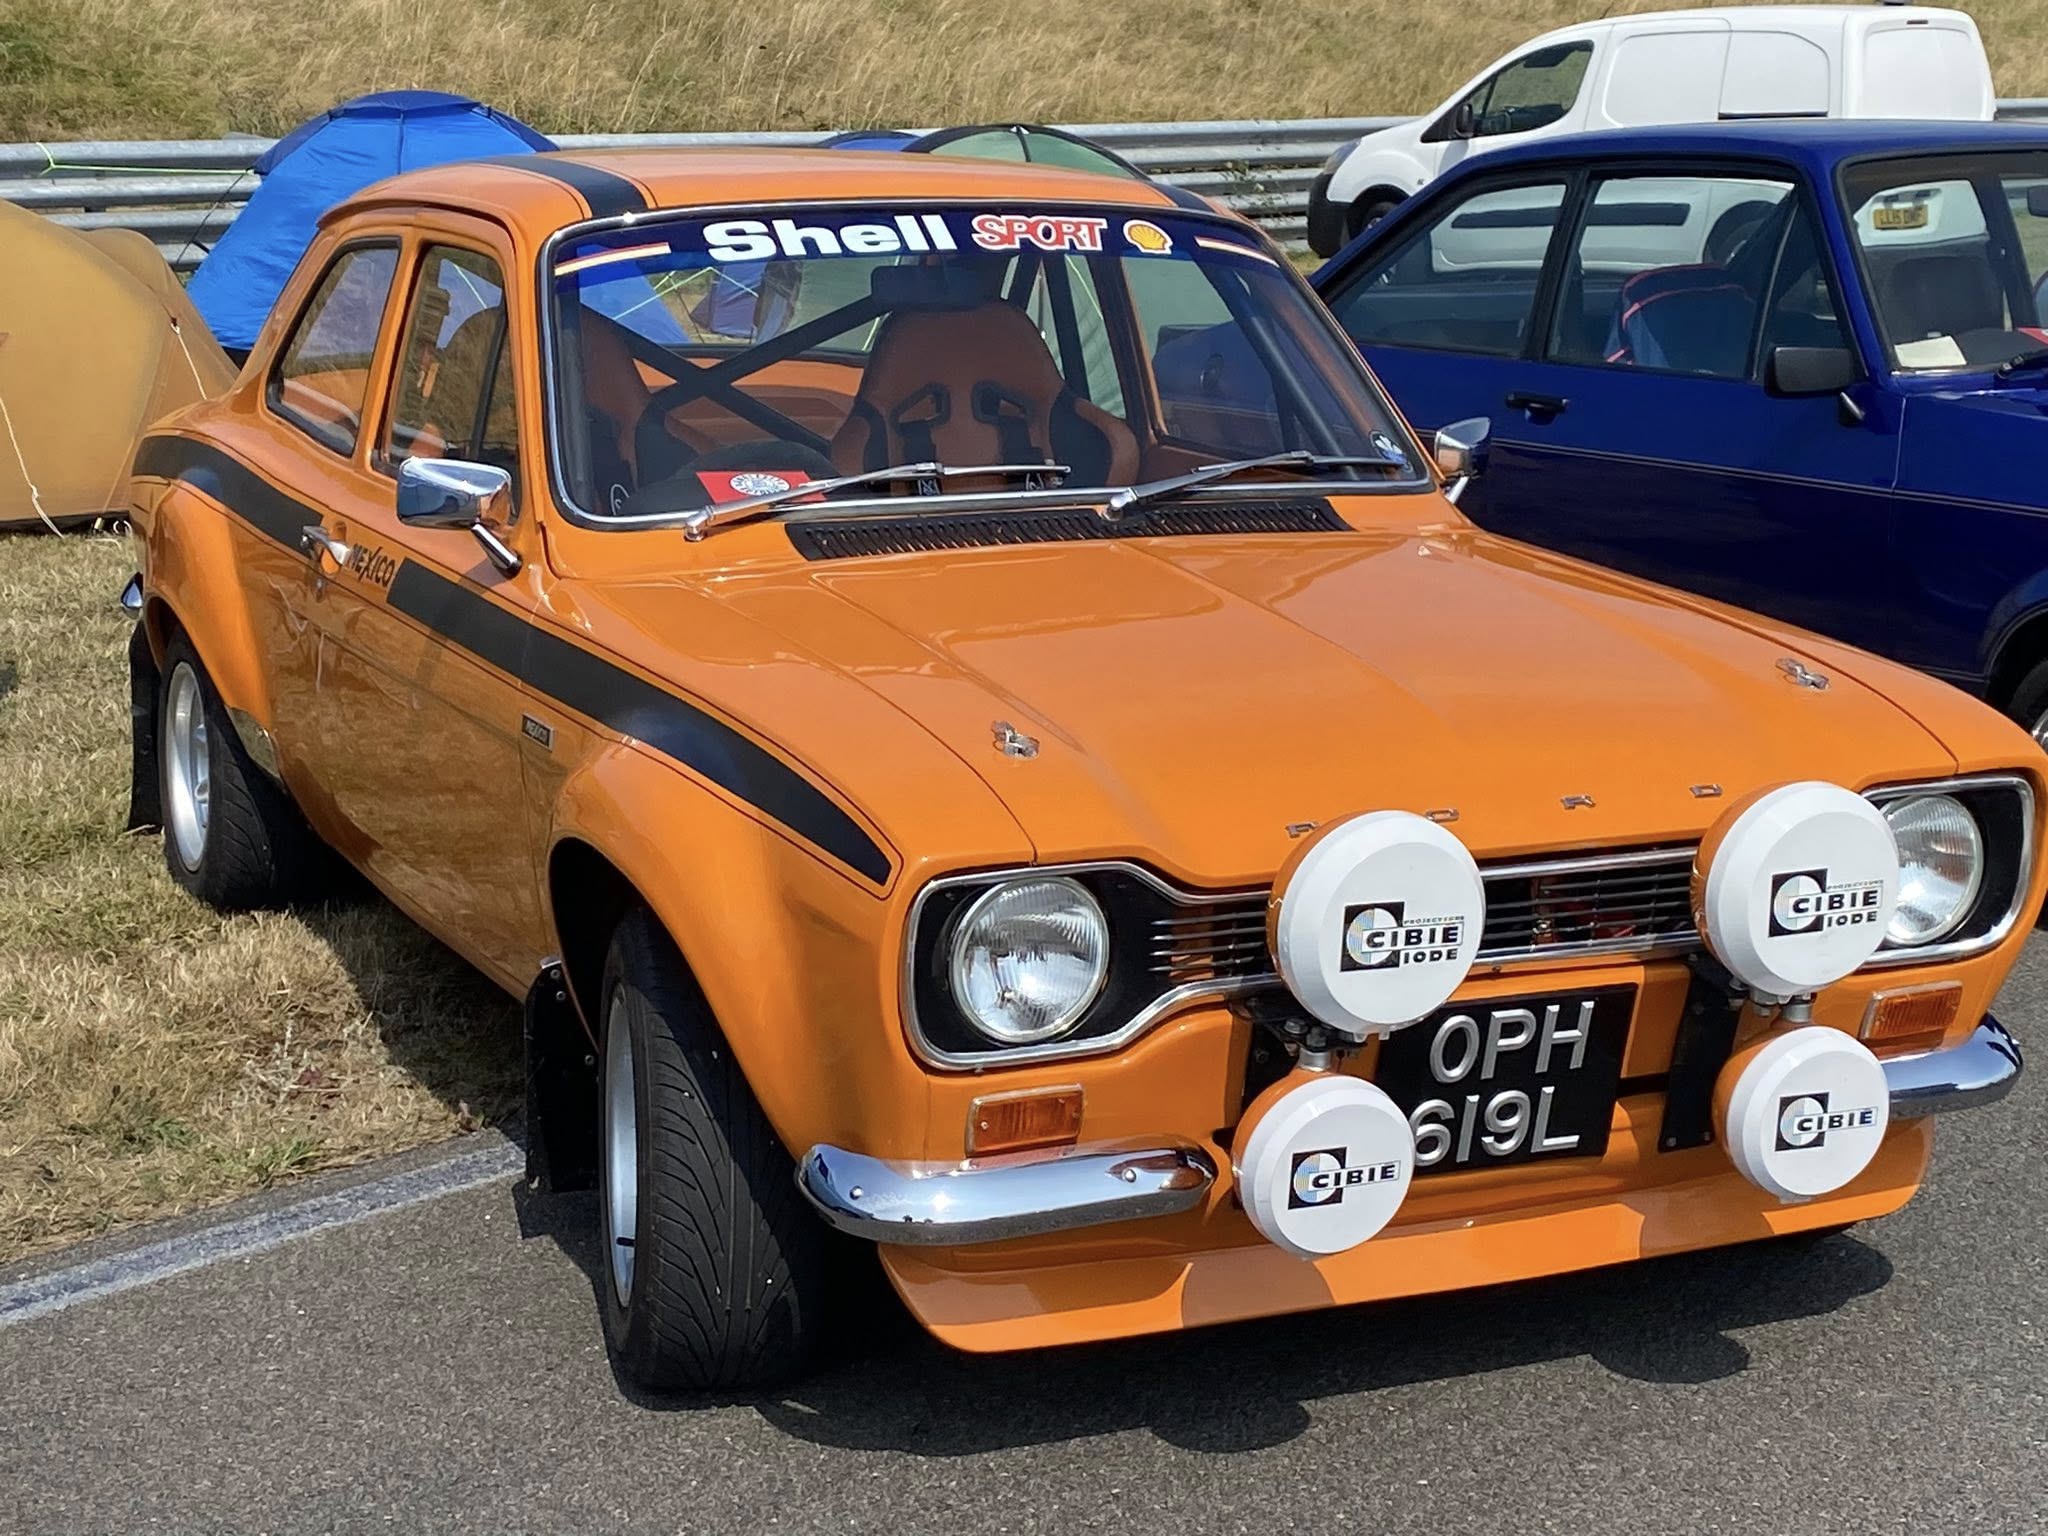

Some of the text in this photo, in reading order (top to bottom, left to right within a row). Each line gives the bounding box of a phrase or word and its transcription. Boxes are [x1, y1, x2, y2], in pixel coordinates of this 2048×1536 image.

[702, 213, 1108, 262] Shell SPORT
[345, 543, 395, 587] MEXICO
[1792, 889, 1879, 914] CIBIE
[1827, 911, 1878, 927] IODE
[1365, 926, 1459, 948] CIBIE
[1403, 948, 1458, 965] IODE
[1429, 1001, 1595, 1084] OPH
[1410, 1086, 1581, 1167] 619L
[1797, 1110, 1873, 1132] CIBIE
[1311, 1163, 1396, 1189] CIBIE
